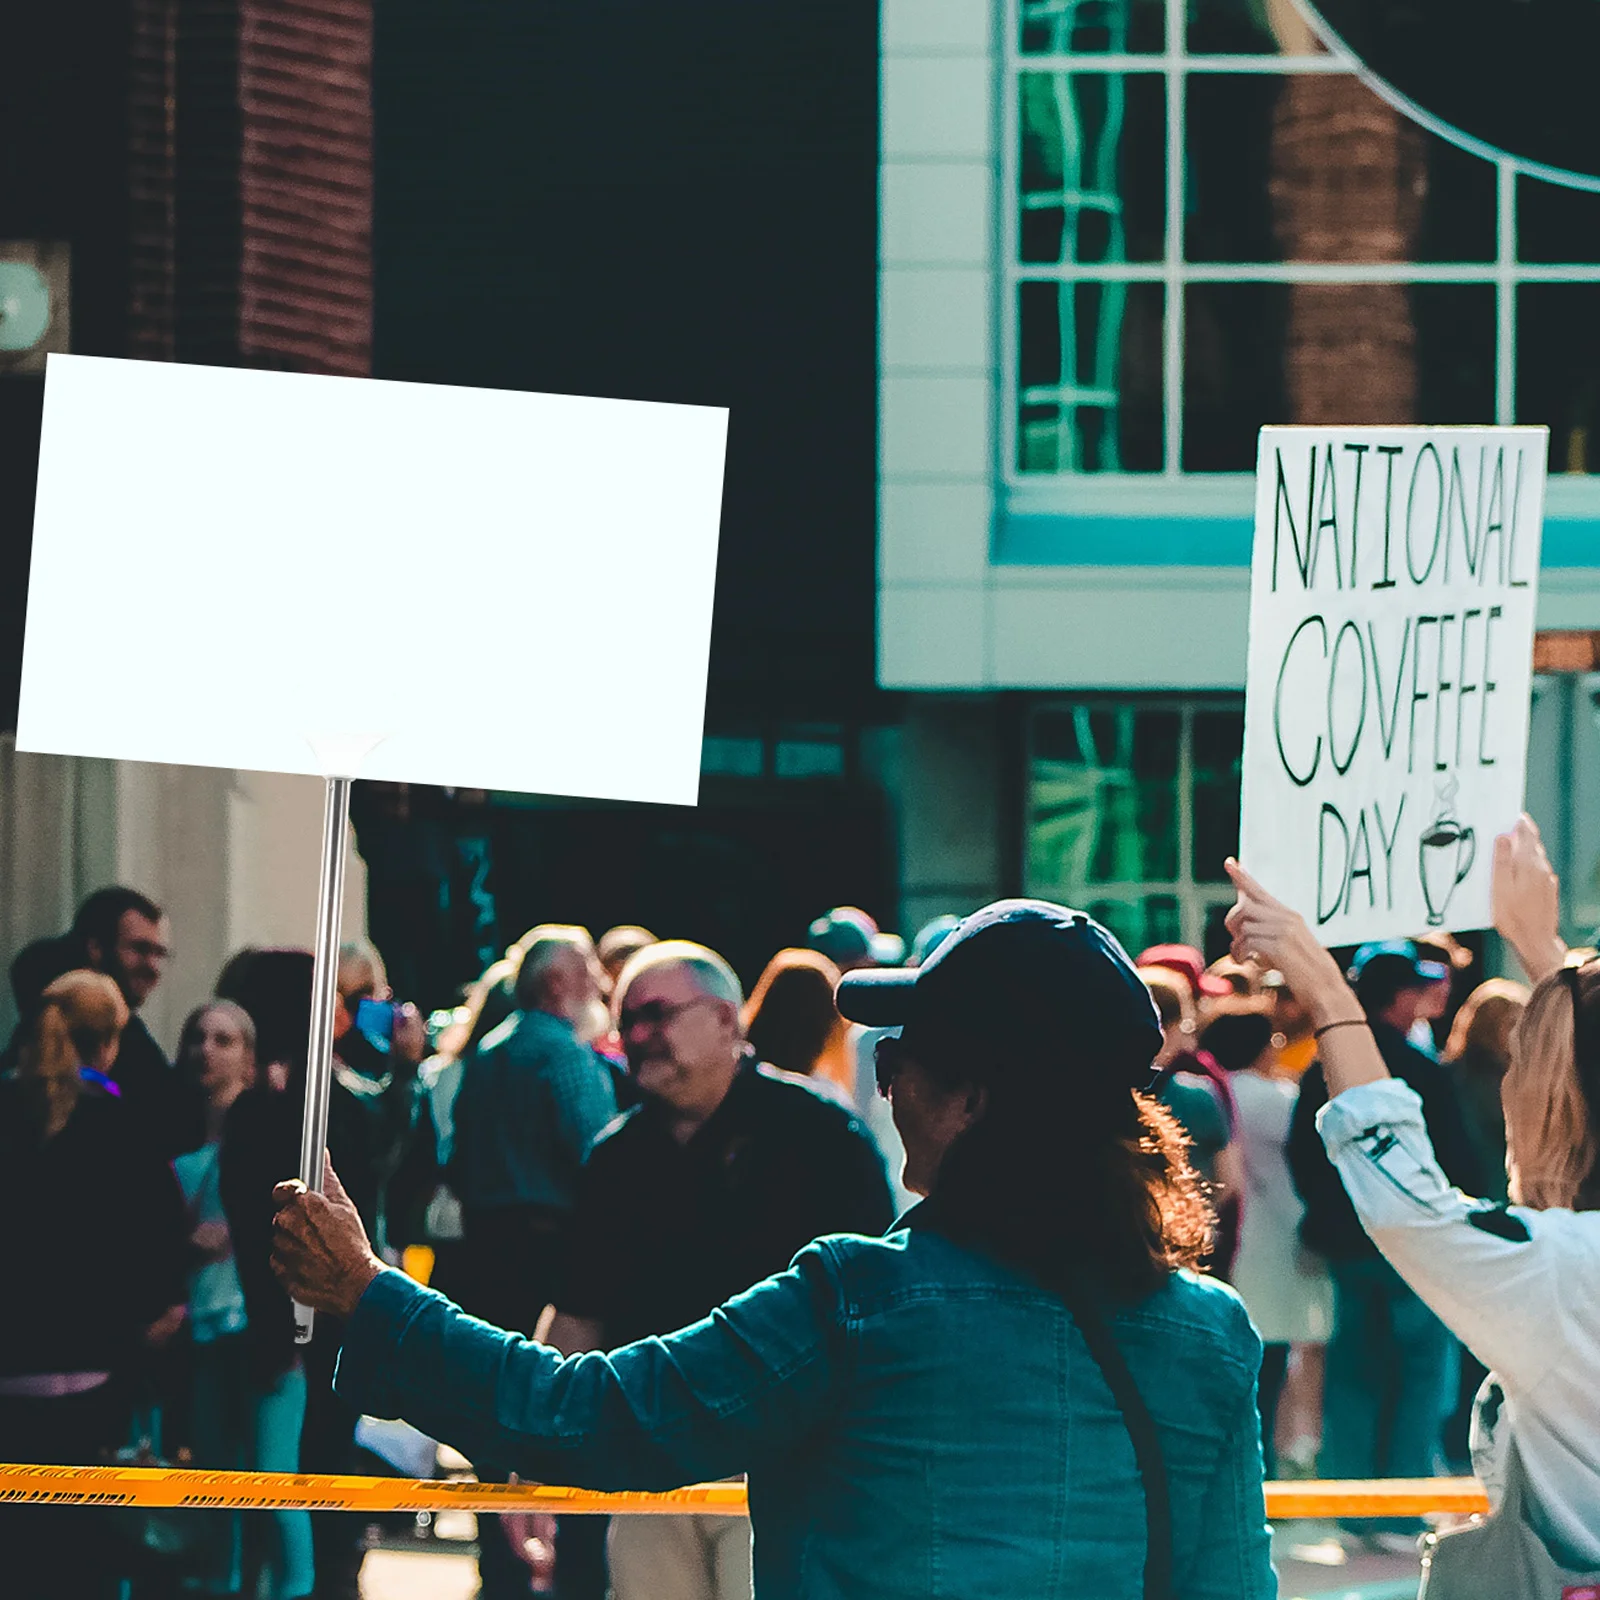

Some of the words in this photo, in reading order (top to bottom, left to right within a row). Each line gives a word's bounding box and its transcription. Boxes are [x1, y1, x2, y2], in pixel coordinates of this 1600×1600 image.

[1272, 443, 1528, 592] NATIONAL
[1274, 606, 1502, 786] COVFEFE
[1317, 794, 1405, 925] DAY
